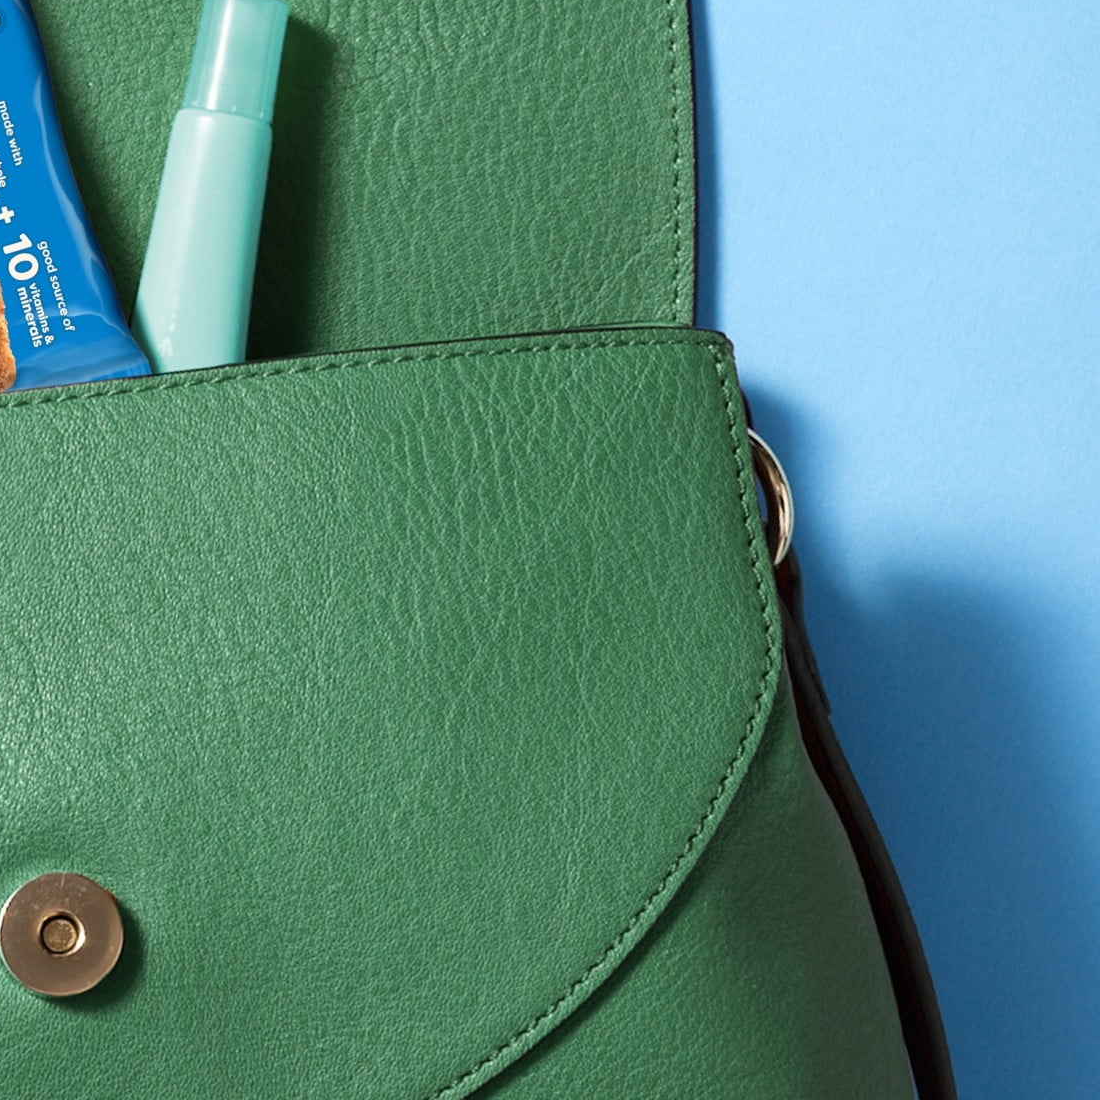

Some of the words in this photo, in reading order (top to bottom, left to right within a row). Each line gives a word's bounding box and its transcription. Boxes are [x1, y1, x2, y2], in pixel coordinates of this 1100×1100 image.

[8, 138, 22, 166] with
[3, 233, 39, 281] 10
[37, 240, 57, 274] good
[50, 275, 68, 317] source
[63, 318, 75, 331] of
[17, 287, 42, 347] minerals
[29, 282, 50, 334] vitamins
[44, 333, 54, 345] &
